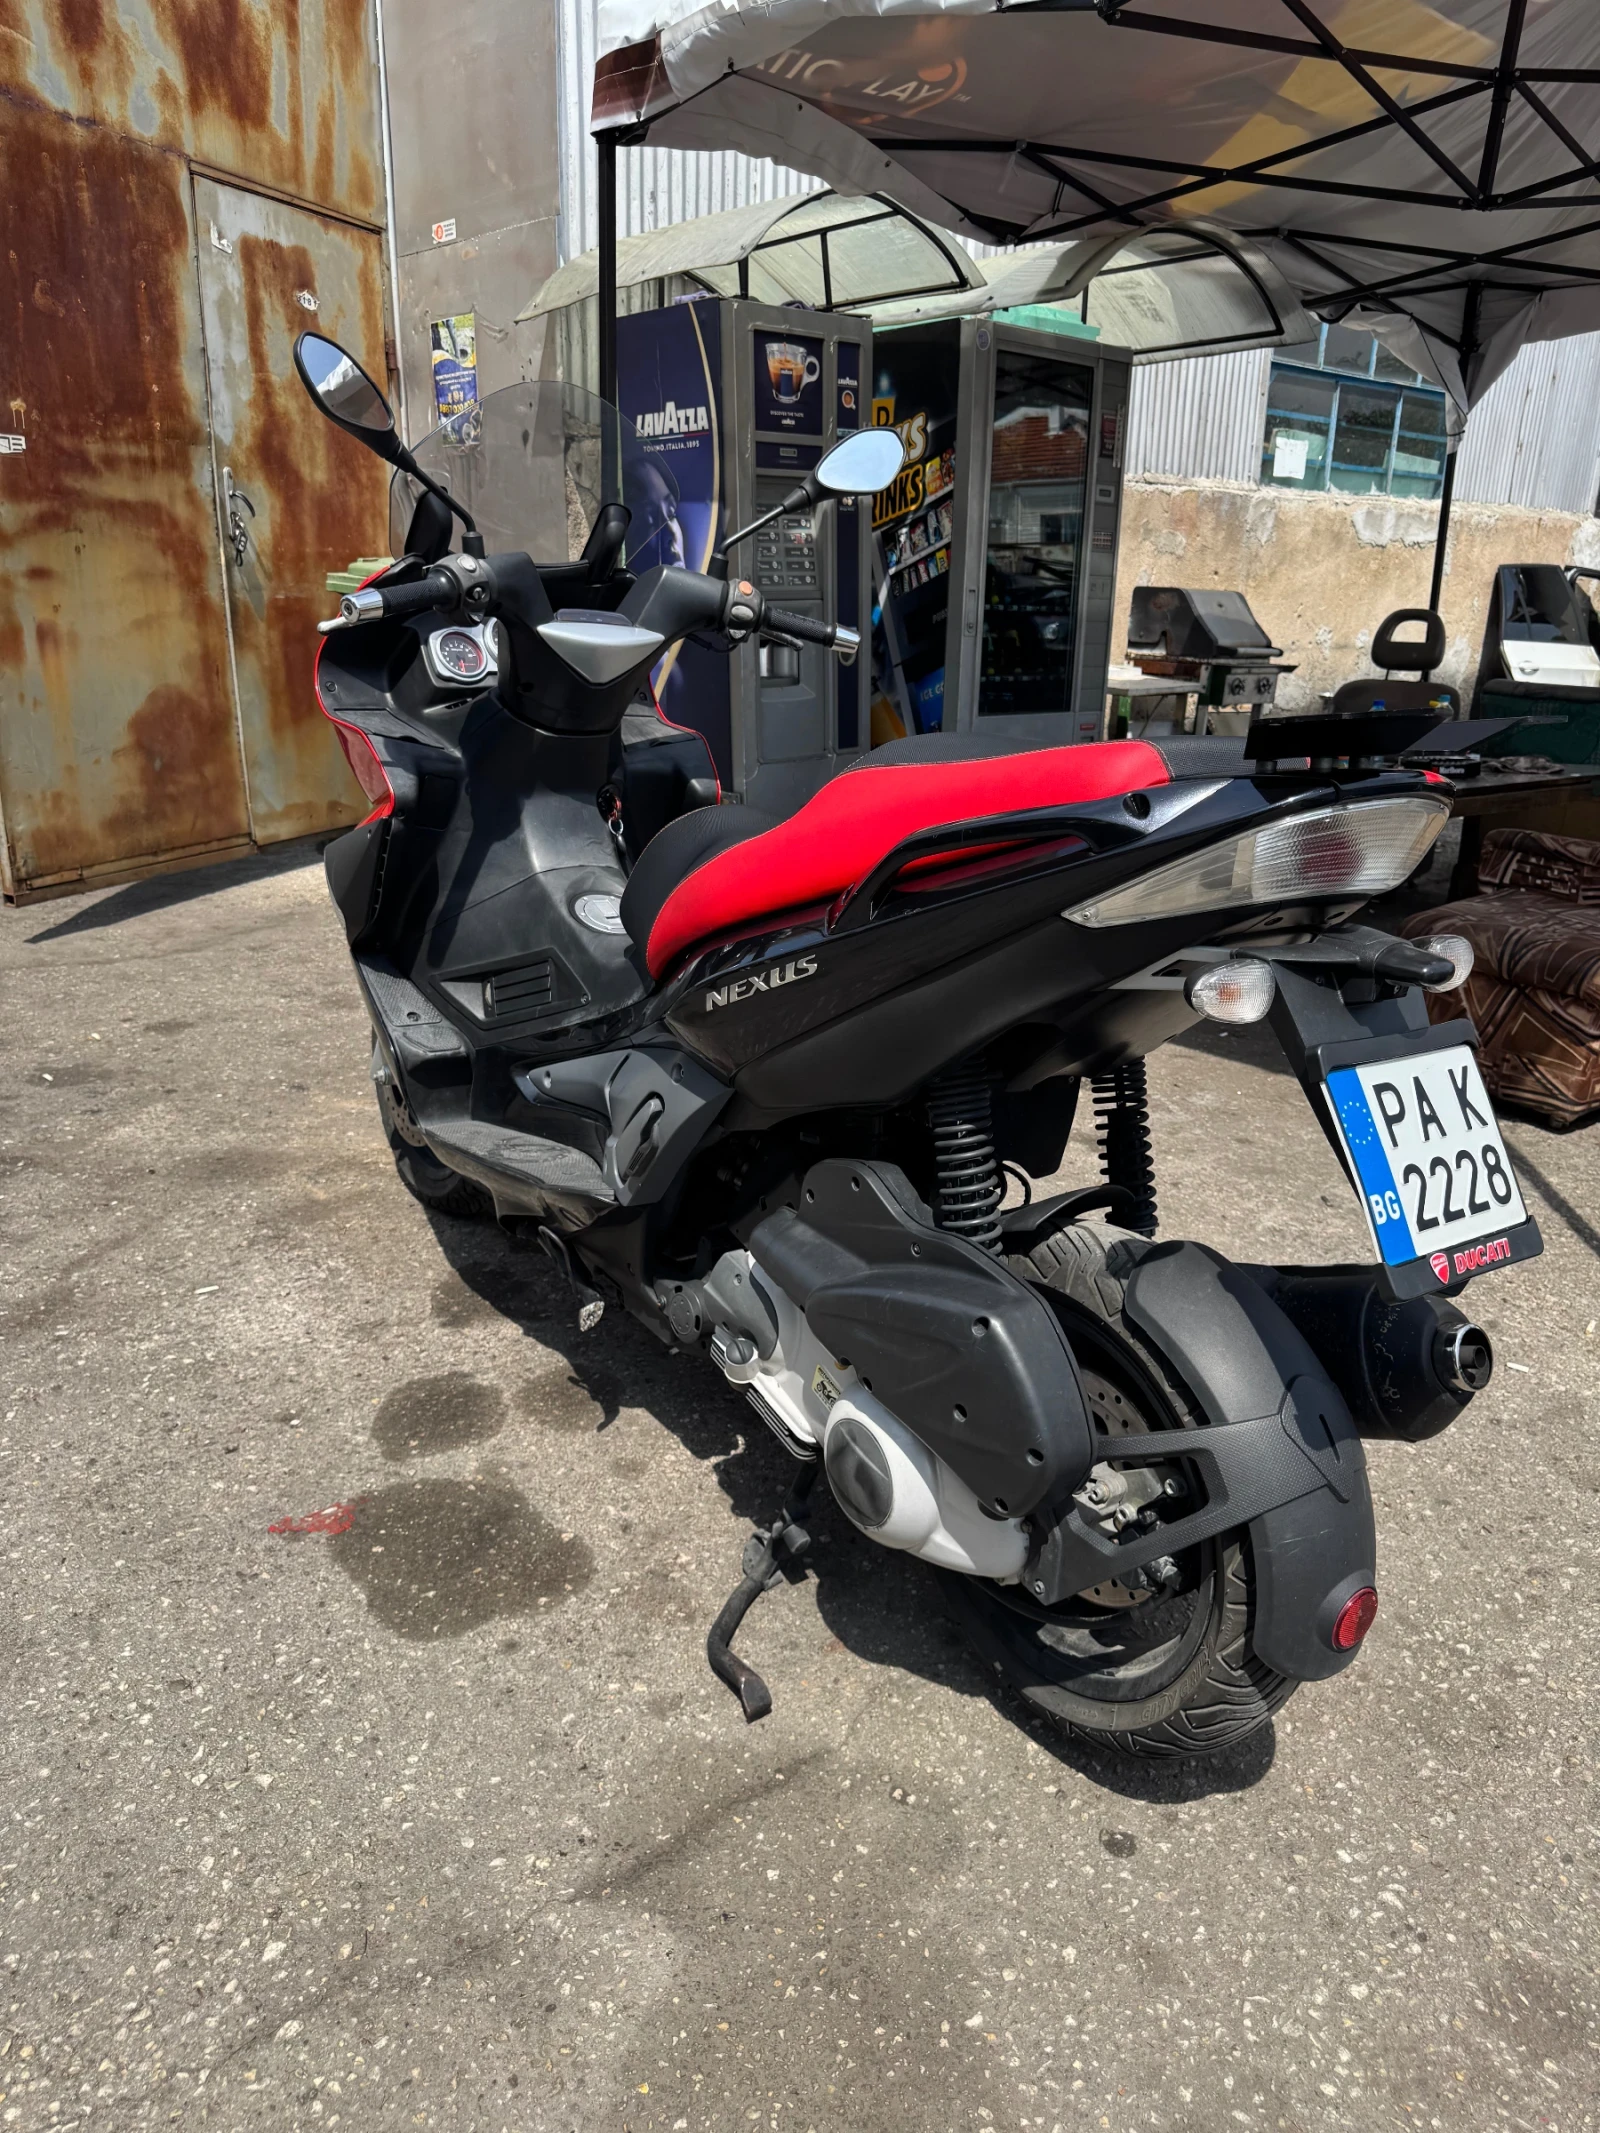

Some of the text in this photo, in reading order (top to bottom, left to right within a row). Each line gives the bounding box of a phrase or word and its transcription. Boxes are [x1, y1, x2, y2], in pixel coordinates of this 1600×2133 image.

[636, 401, 709, 437] LAVAZZA
[705, 954, 818, 1012] NEXUS
[1402, 1143, 1512, 1233] 2228
[1369, 1190, 1401, 1226] BG
[1453, 1237, 1511, 1275] DUCATI
